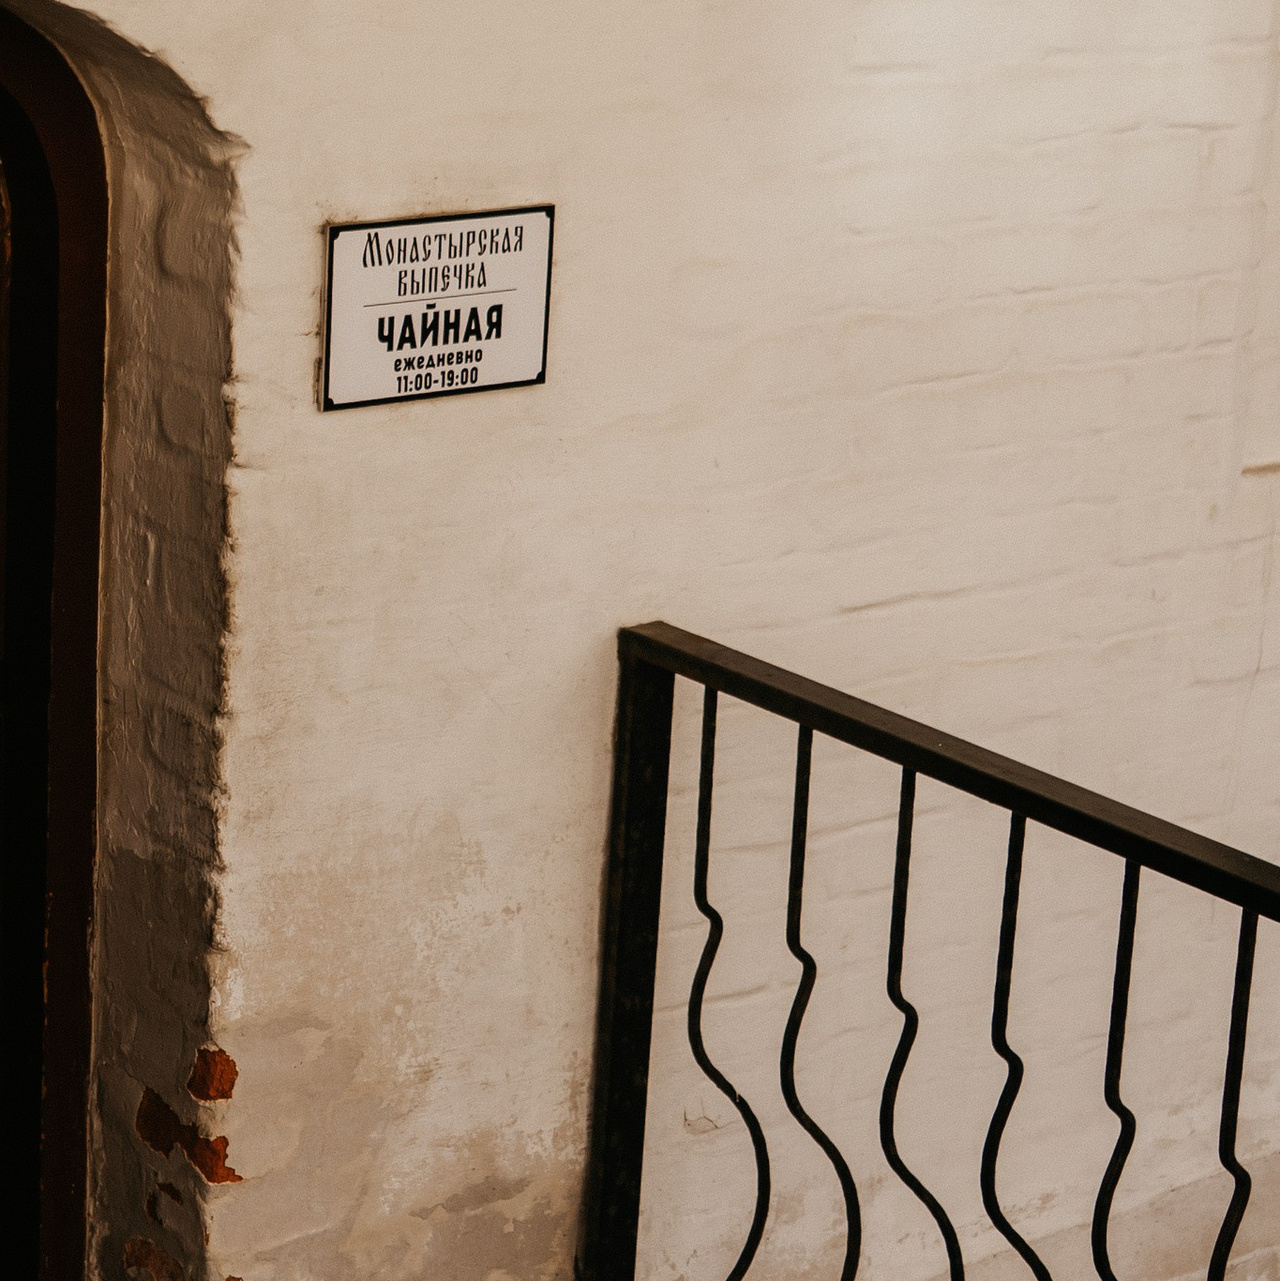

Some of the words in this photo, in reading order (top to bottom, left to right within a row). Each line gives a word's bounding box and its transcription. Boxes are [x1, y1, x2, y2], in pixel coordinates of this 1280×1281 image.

[377, 302, 504, 353] ЧАЙНАЯ
[393, 348, 483, 373] ежедневно
[396, 366, 479, 394] 11:00-19:00
